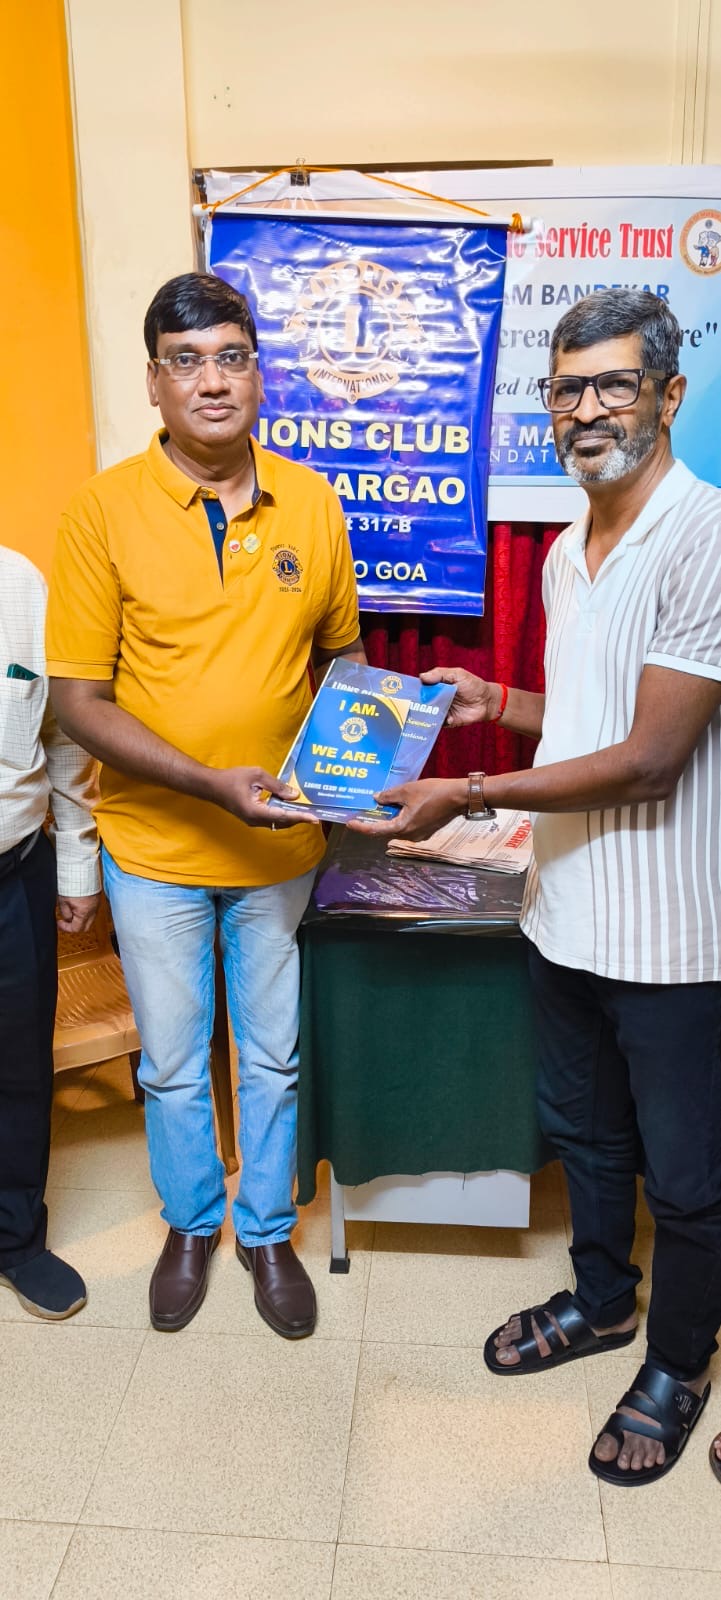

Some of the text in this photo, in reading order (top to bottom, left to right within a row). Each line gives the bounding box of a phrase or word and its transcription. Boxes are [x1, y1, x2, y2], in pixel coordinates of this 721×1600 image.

[620, 223, 674, 258] Trust
[495, 376, 520, 396] ed
[258, 417, 470, 454] IONS CLUB
[359, 517, 412, 533] 317-B
[376, 561, 428, 582] GOA
[338, 699, 380, 717] I AM.
[311, 743, 381, 765] WE ARE.
[314, 761, 369, 779] LIONS
